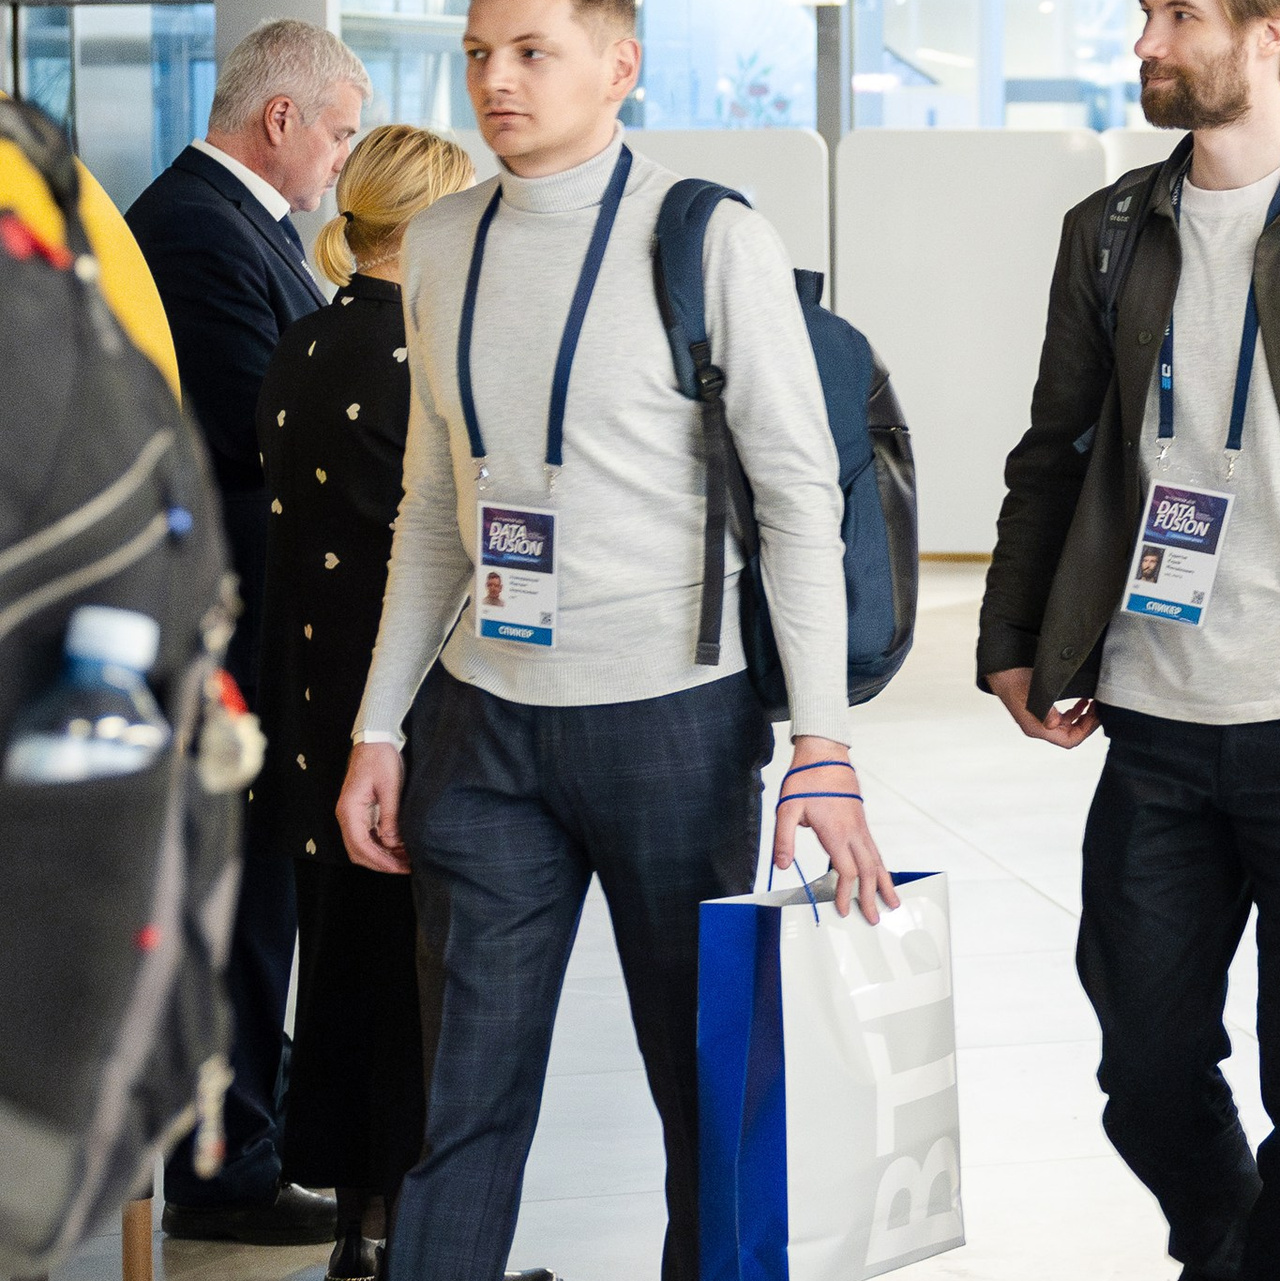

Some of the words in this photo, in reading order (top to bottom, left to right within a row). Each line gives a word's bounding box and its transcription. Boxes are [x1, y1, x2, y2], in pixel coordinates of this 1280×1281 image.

[1156, 500, 1196, 520] DATA
[489, 521, 527, 540] DATA
[1153, 515, 1210, 537] FUSION
[489, 537, 543, 556] FUSION
